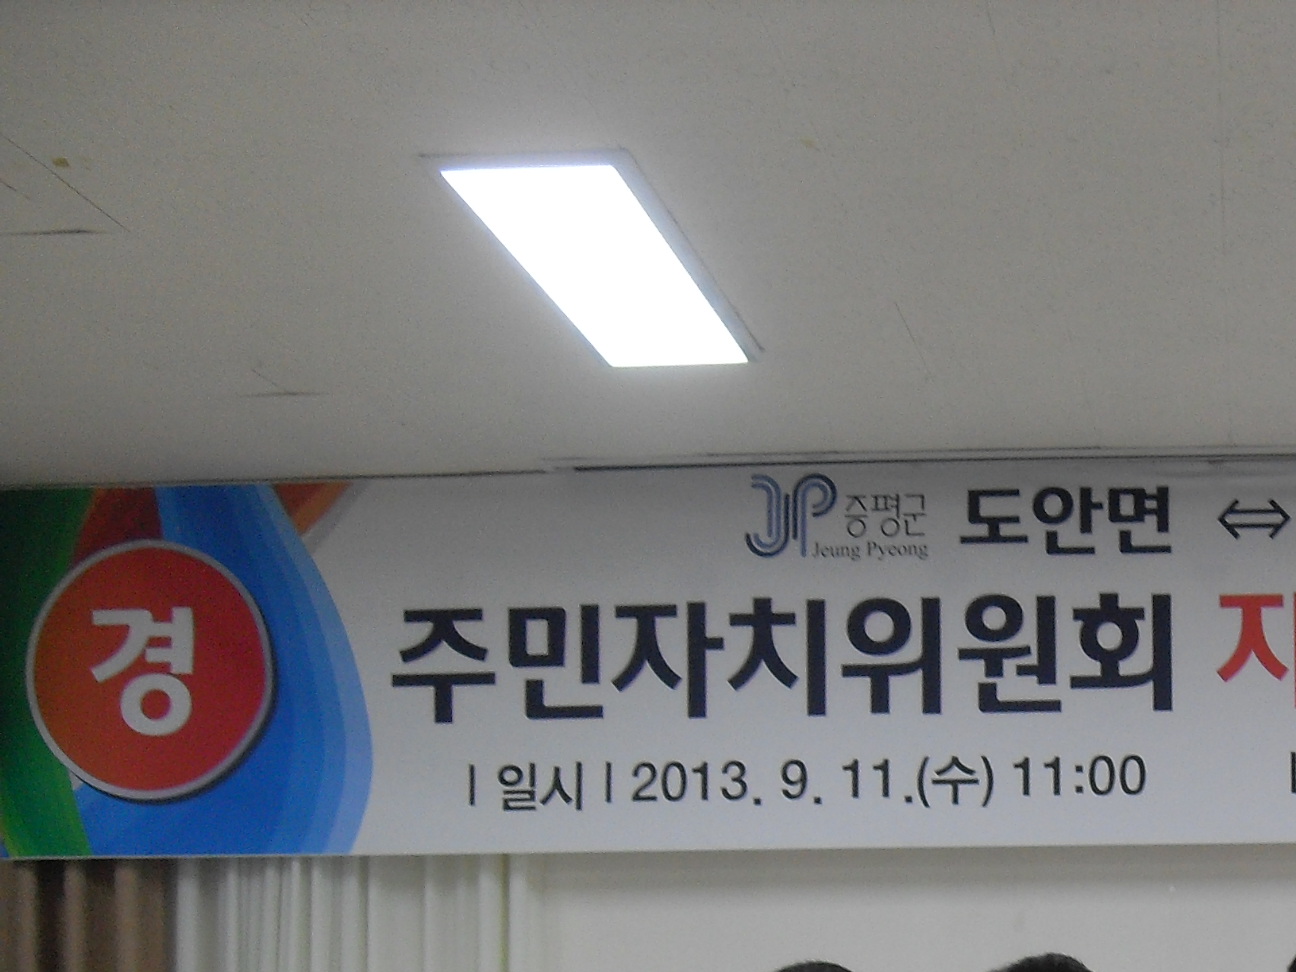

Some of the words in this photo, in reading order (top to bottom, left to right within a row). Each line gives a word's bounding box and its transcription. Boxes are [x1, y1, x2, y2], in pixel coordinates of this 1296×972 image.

[845, 493, 927, 538] 증평군
[960, 485, 1172, 556] 도안면
[812, 542, 860, 560] Jeung
[867, 541, 929, 560] Pyeong
[88, 606, 195, 738] 경
[391, 591, 1173, 724] 주민자치위원회
[632, 760, 763, 808] 2013.
[780, 759, 823, 806] 9.
[1012, 754, 1147, 798] 11:00
